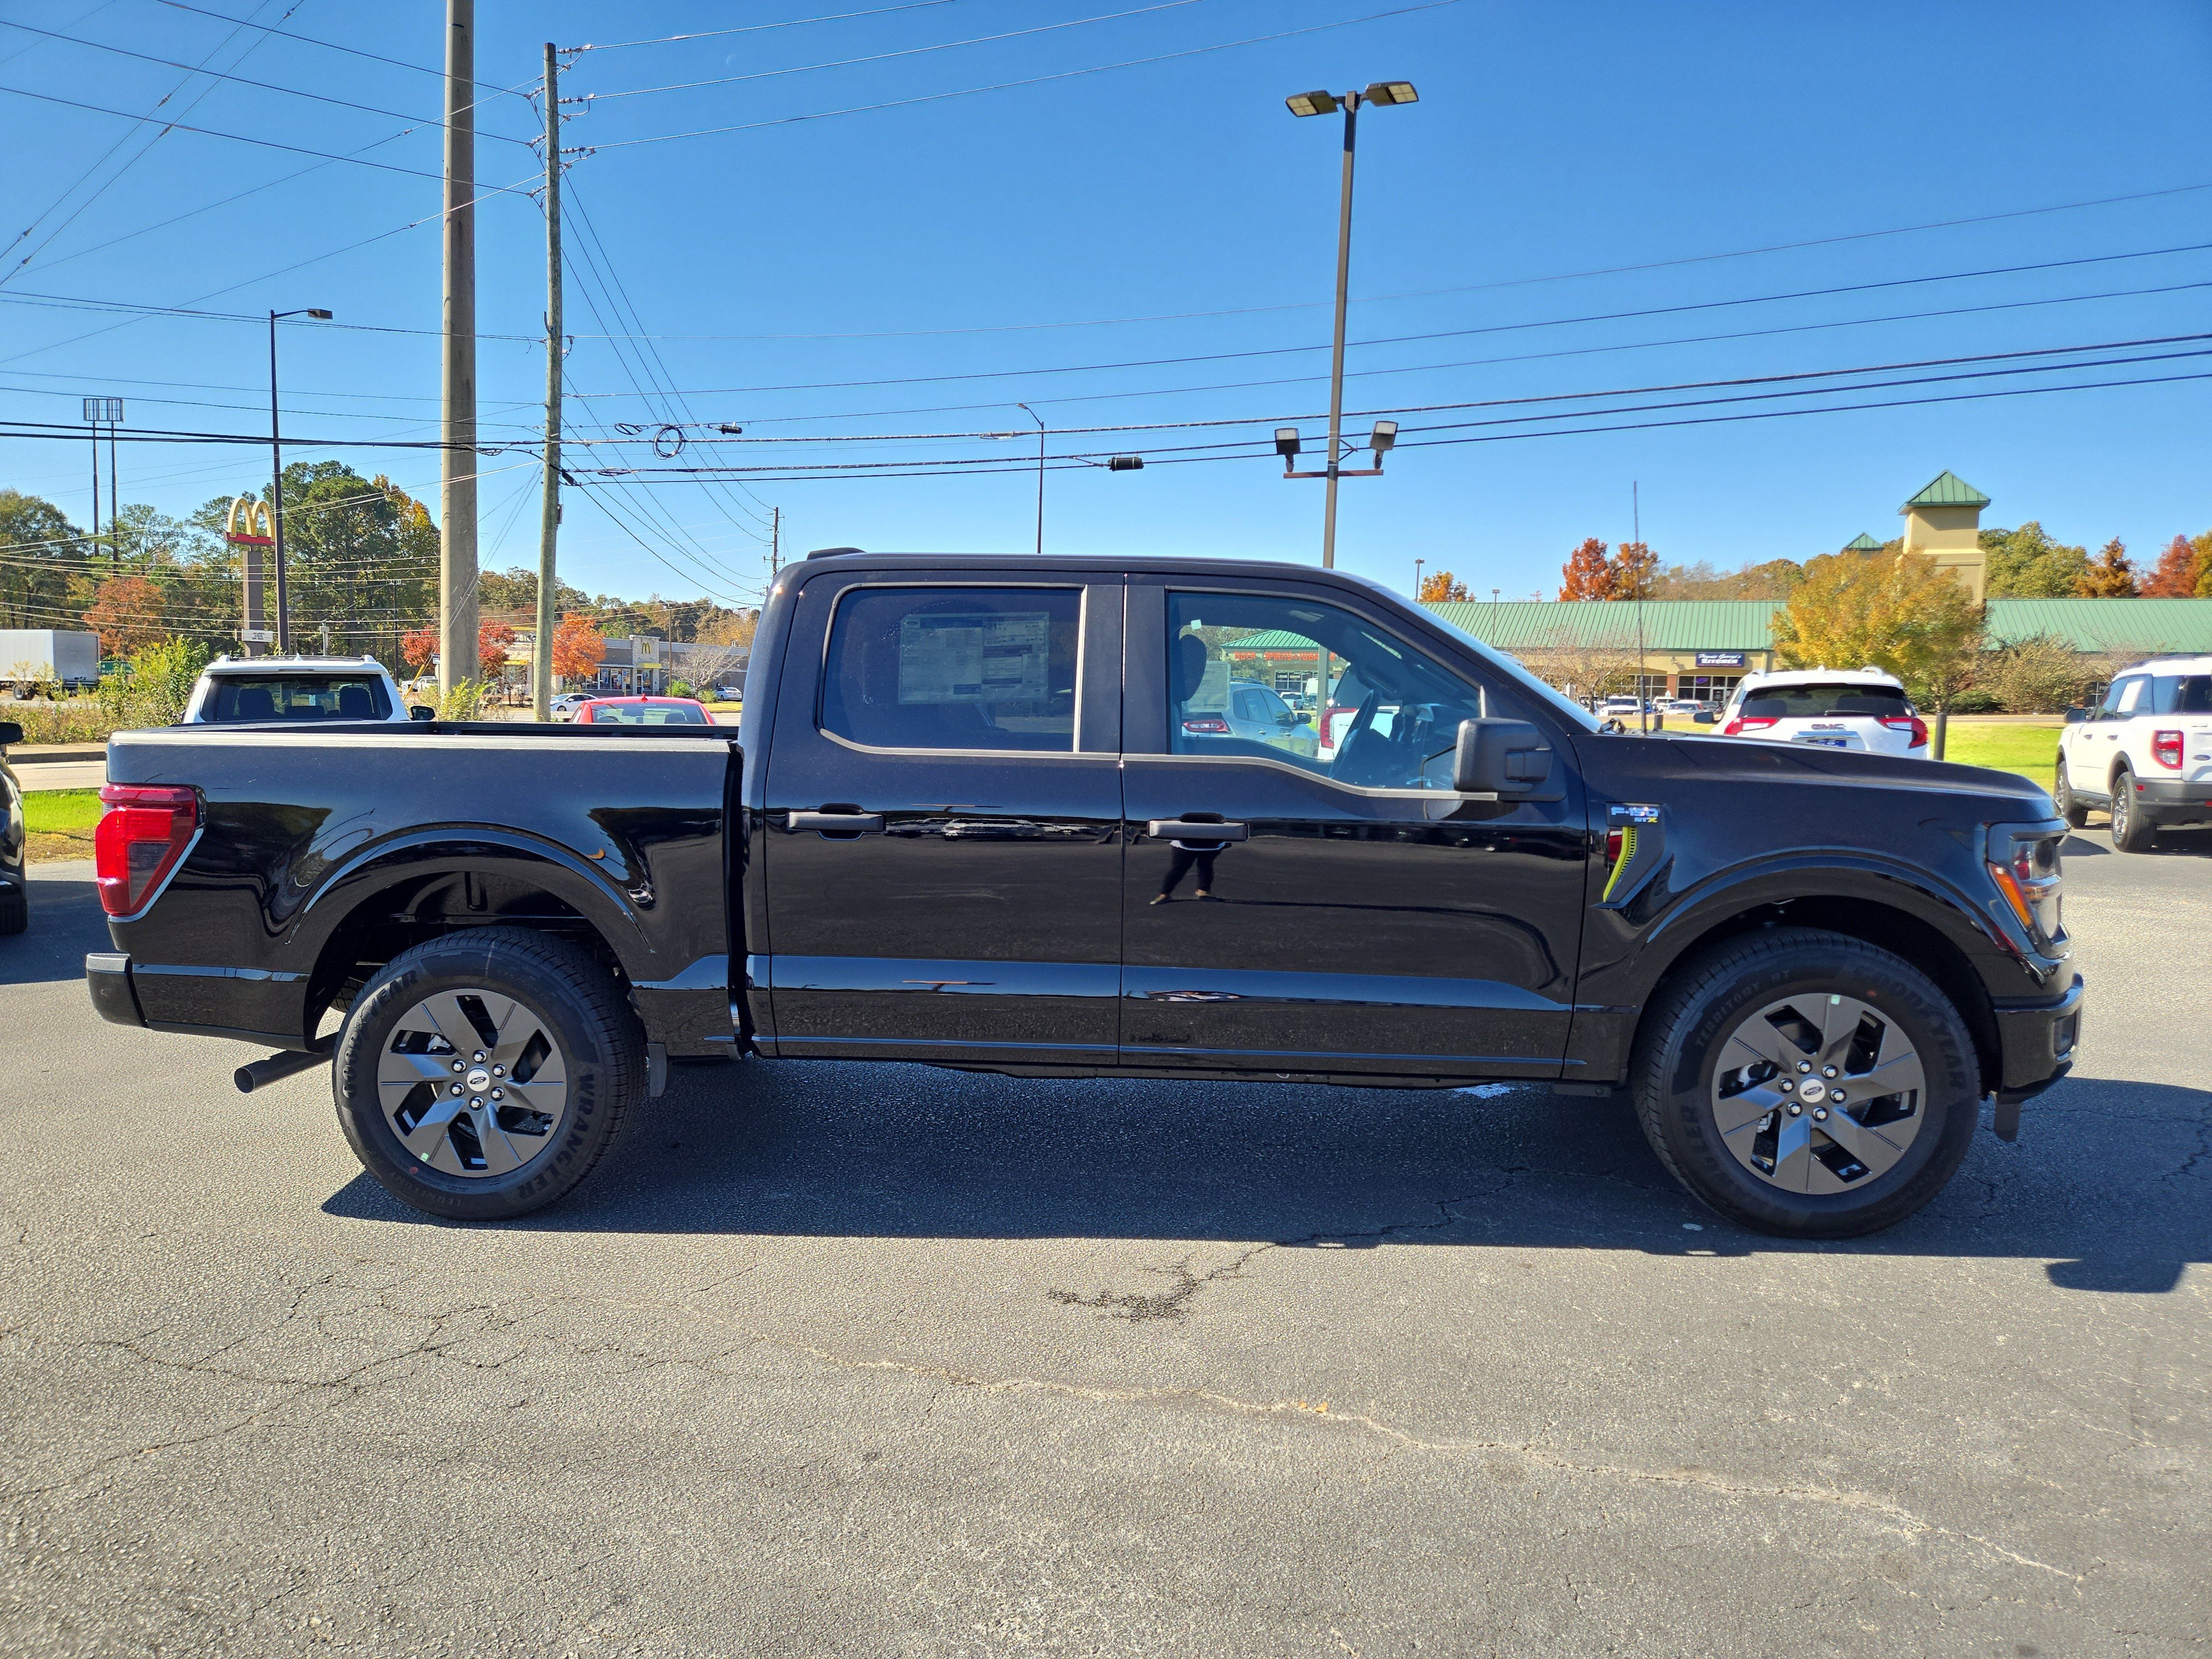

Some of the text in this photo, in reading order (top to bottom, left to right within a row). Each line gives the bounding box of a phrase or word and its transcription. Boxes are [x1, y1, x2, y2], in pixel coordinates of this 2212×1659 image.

[1299, 652, 1336, 661] TOBAO
[343, 969, 416, 1098] GOODYEAR
[517, 1073, 596, 1199] WRANGLER
